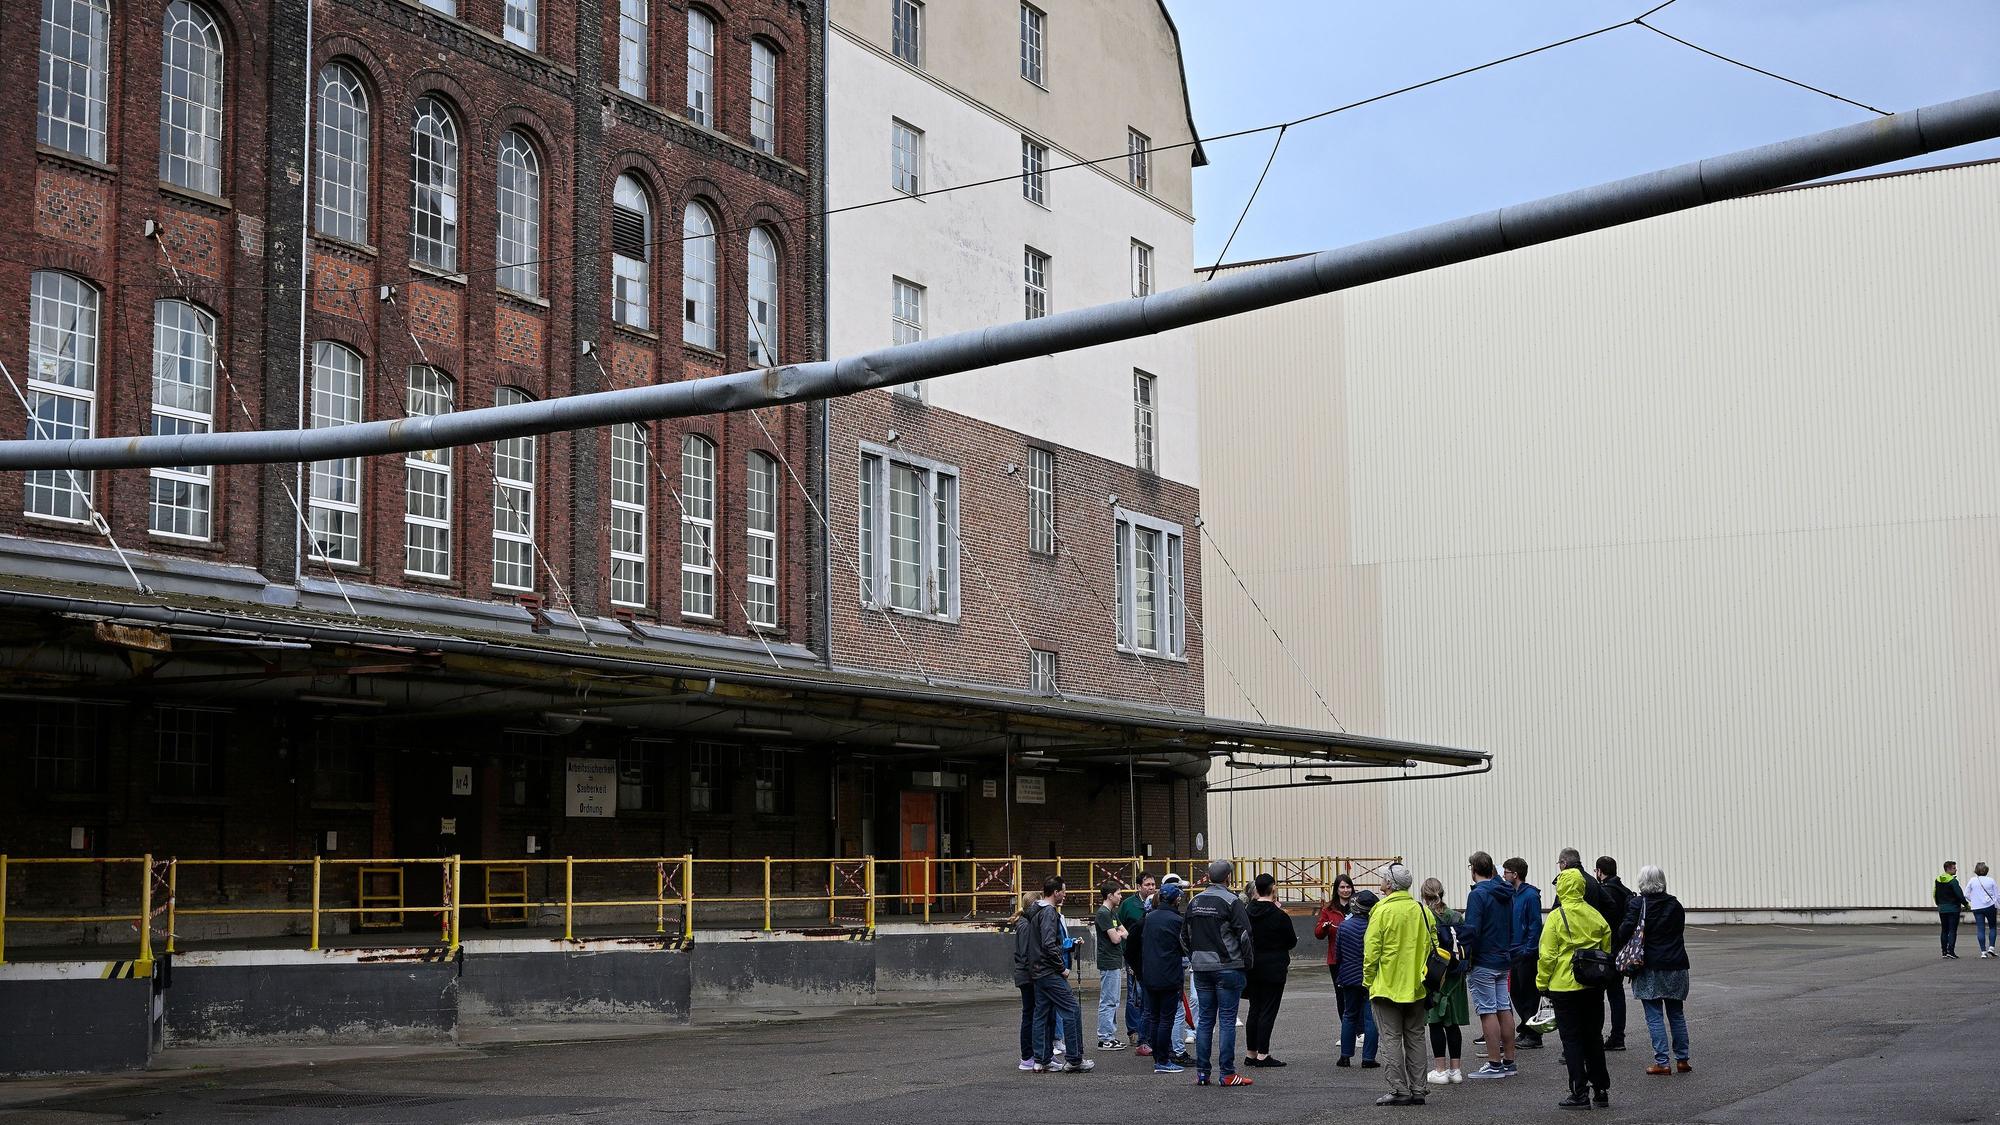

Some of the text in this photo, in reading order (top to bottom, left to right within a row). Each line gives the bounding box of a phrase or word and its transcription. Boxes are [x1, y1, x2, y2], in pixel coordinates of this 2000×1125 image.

[568, 762, 615, 774] Arbeitssicherheit
[576, 783, 607, 794] Sauberkeit
[580, 802, 603, 816] Ordnung
